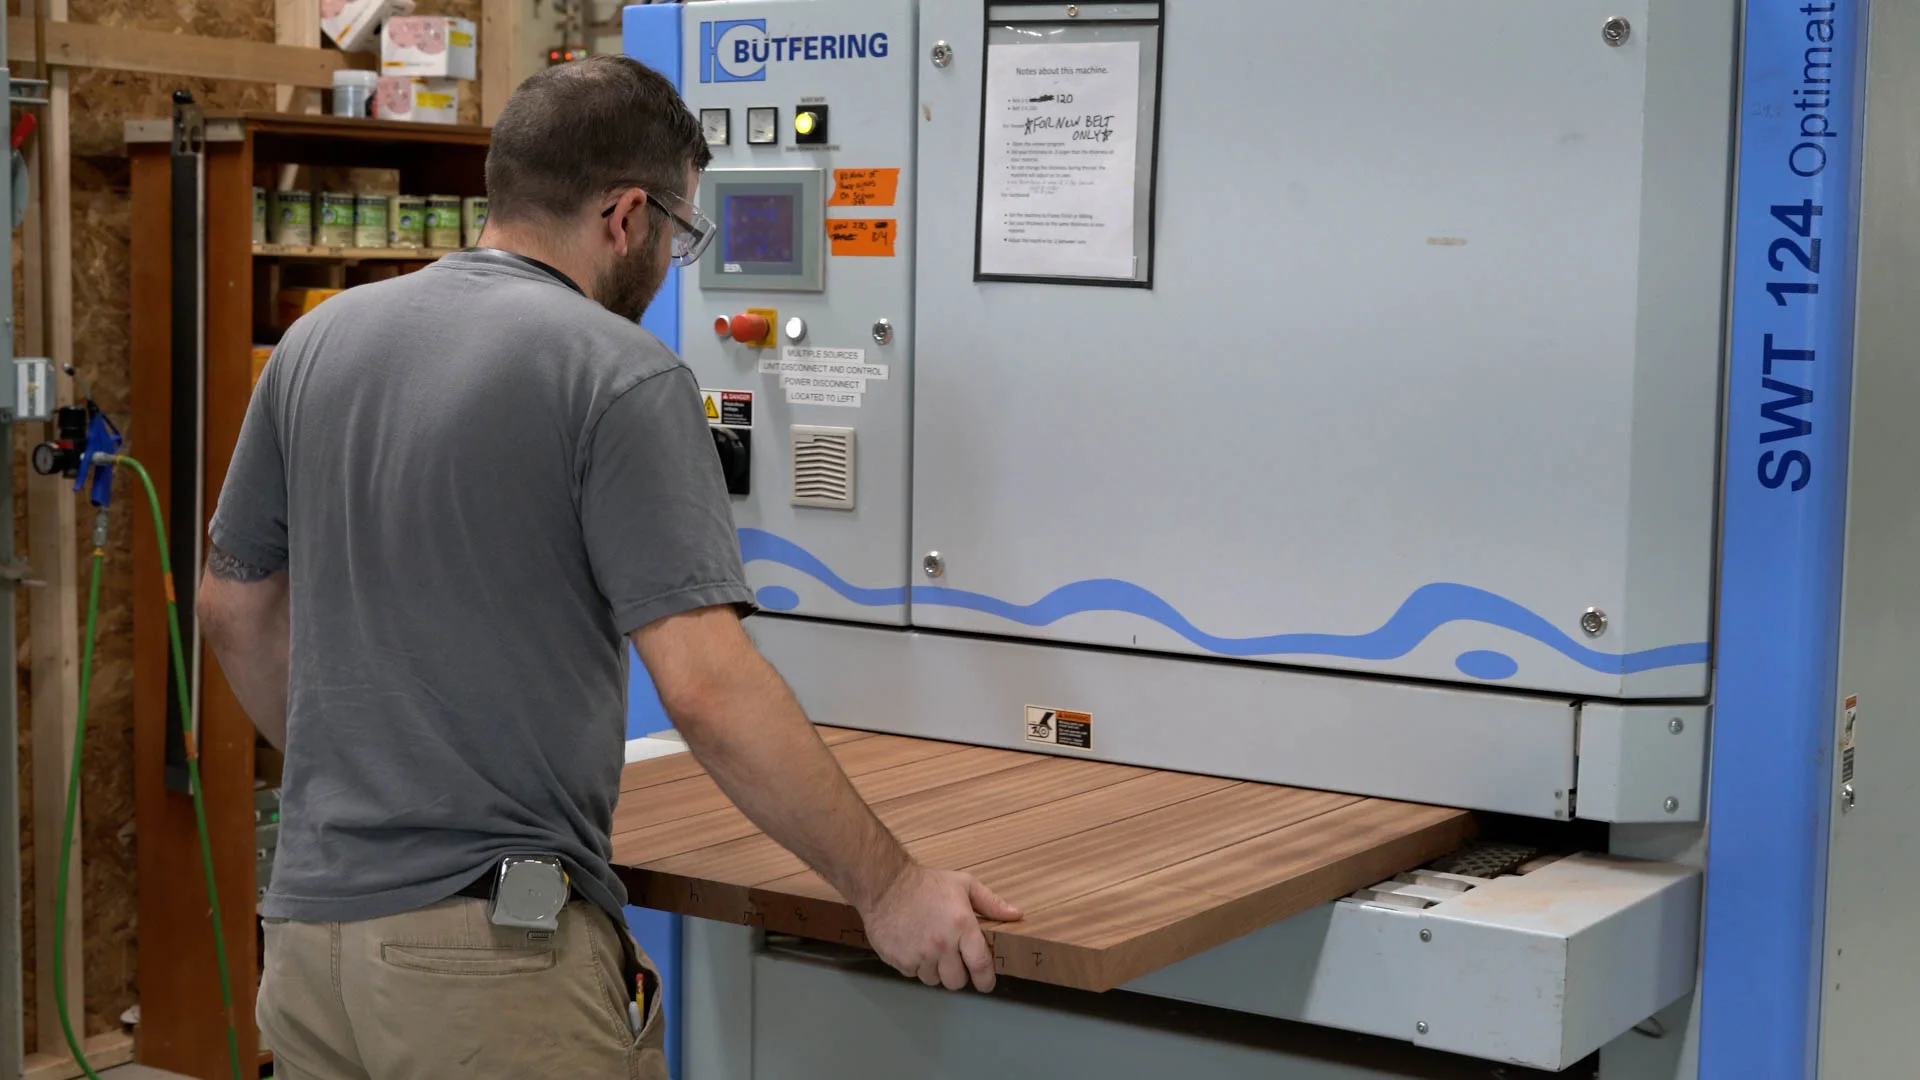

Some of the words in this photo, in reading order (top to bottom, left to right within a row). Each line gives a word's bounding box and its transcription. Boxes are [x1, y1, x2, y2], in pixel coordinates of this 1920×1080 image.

[734, 32, 889, 63] BÜTFERING
[1016, 67, 1037, 76] Notes
[1039, 67, 1060, 76] about
[1061, 67, 1074, 76] this
[1789, 2, 1837, 178] Optimat
[1056, 94, 1074, 104] 120
[1085, 115, 1115, 128] BELT
[1072, 129, 1101, 142] ONLY
[1766, 199, 1824, 307] 124
[787, 349, 822, 359] MULTIPLE
[823, 351, 859, 360] SOURCES
[763, 362, 780, 371] UNIT
[781, 364, 828, 374] DISCONNECT
[829, 366, 845, 374] AND
[846, 367, 883, 376] CONTROL
[784, 377, 811, 387] POWER
[812, 379, 860, 389] DISCONNECT
[791, 393, 824, 402] LOCATED
[826, 394, 836, 402] TO
[837, 395, 855, 403] LEFT
[1757, 333, 1815, 492] SWT
